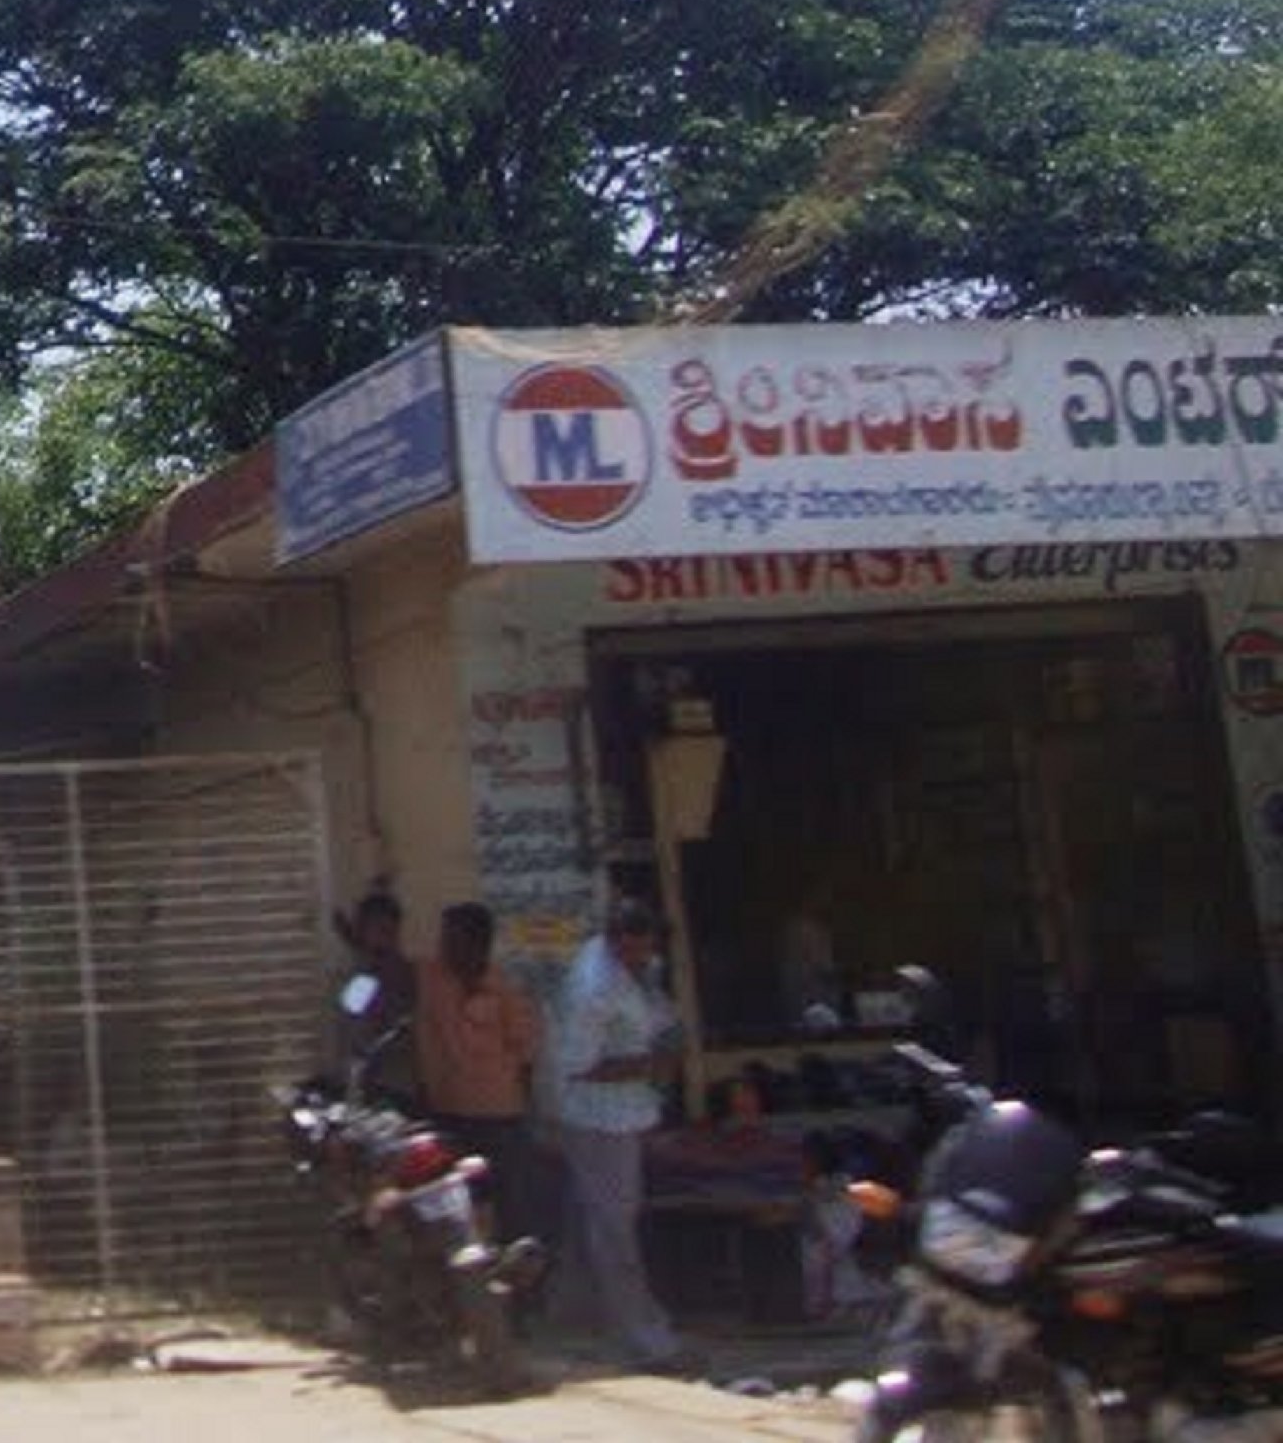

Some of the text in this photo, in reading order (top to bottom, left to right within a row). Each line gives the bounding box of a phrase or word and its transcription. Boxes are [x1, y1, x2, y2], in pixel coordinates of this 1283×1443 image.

[669, 341, 1024, 480] ಶ್ರೀನಿವಾಸ
[532, 412, 623, 481] ML
[606, 548, 951, 603] SRINIVASA
